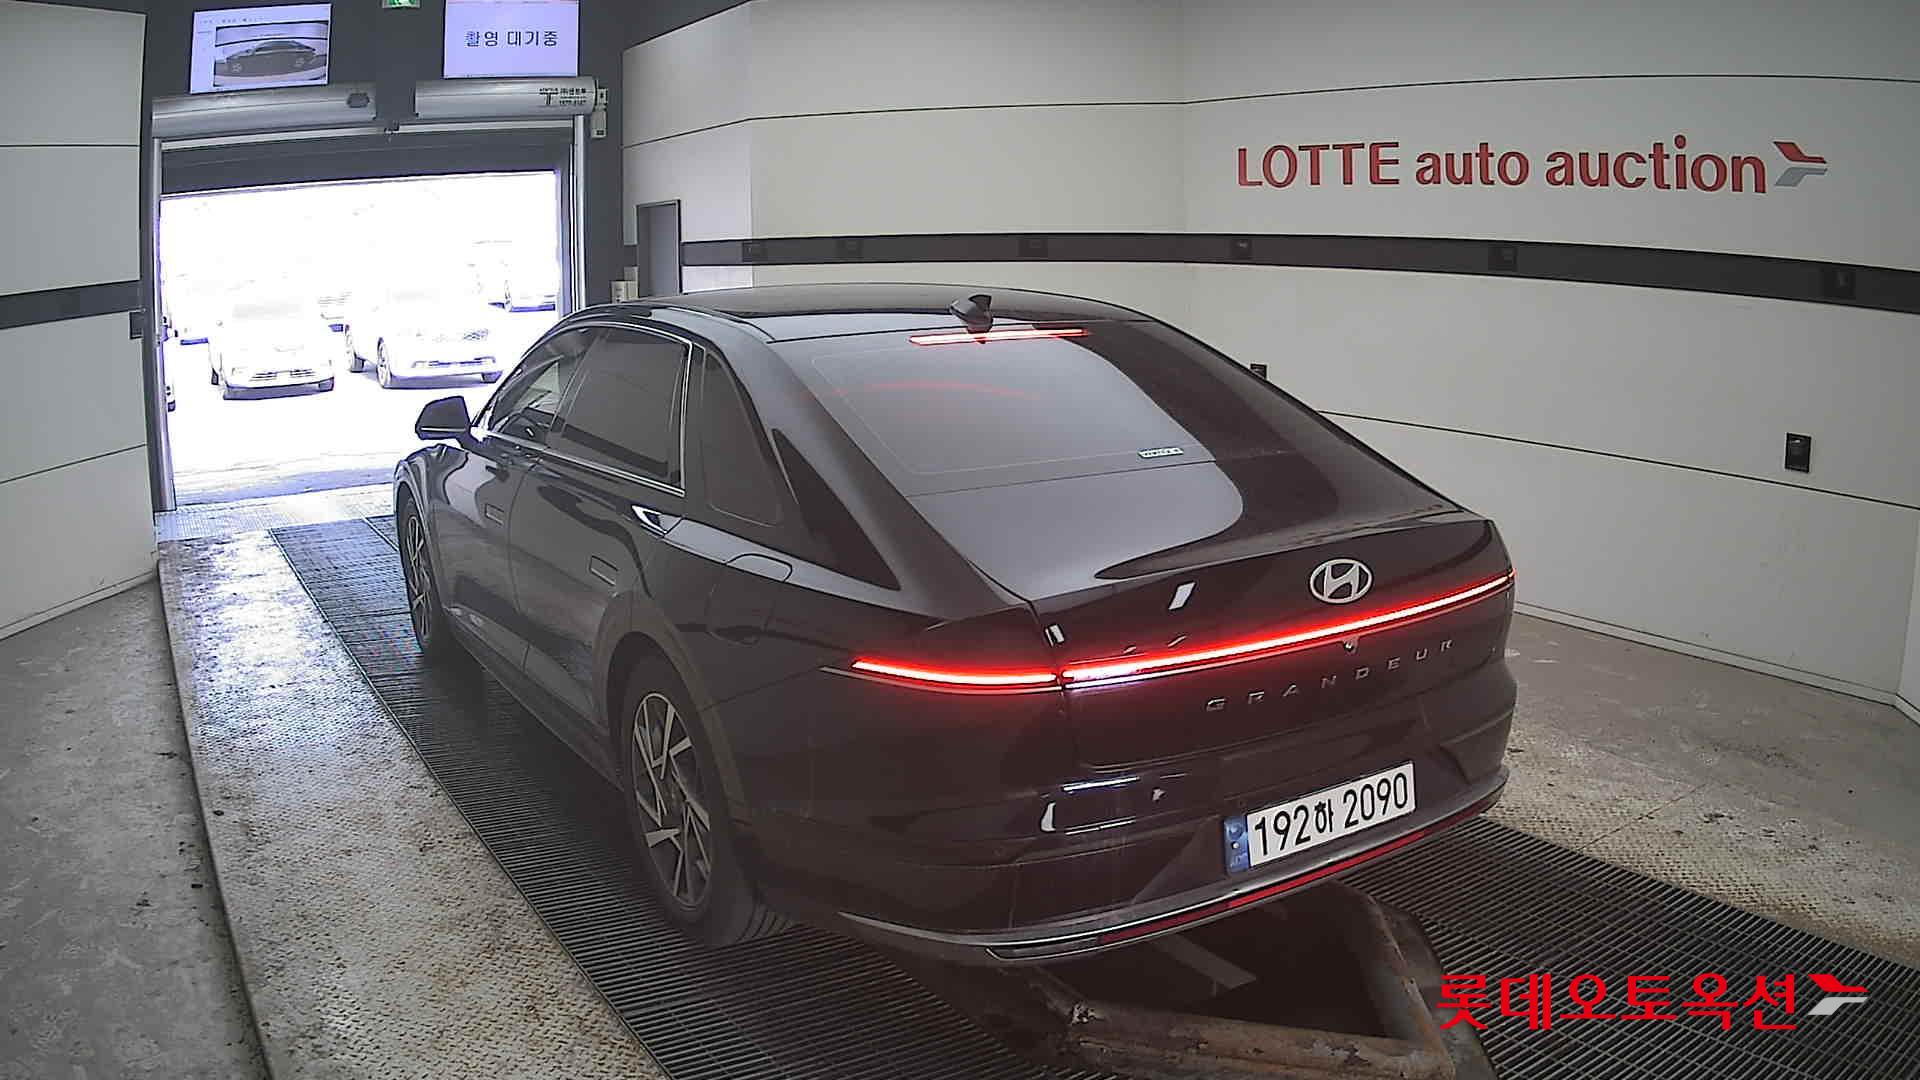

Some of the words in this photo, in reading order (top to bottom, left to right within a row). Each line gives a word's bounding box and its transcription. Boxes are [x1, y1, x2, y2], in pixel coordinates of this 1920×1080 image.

[507, 30, 558, 47] 대기중
[1237, 142, 1400, 188] LOTTE
[1415, 142, 1530, 187] auto
[1545, 135, 1766, 194] auction
[1206, 639, 1453, 712] GRANDEUR
[1254, 798, 1334, 856] 192하
[1343, 772, 1408, 829] 2090
